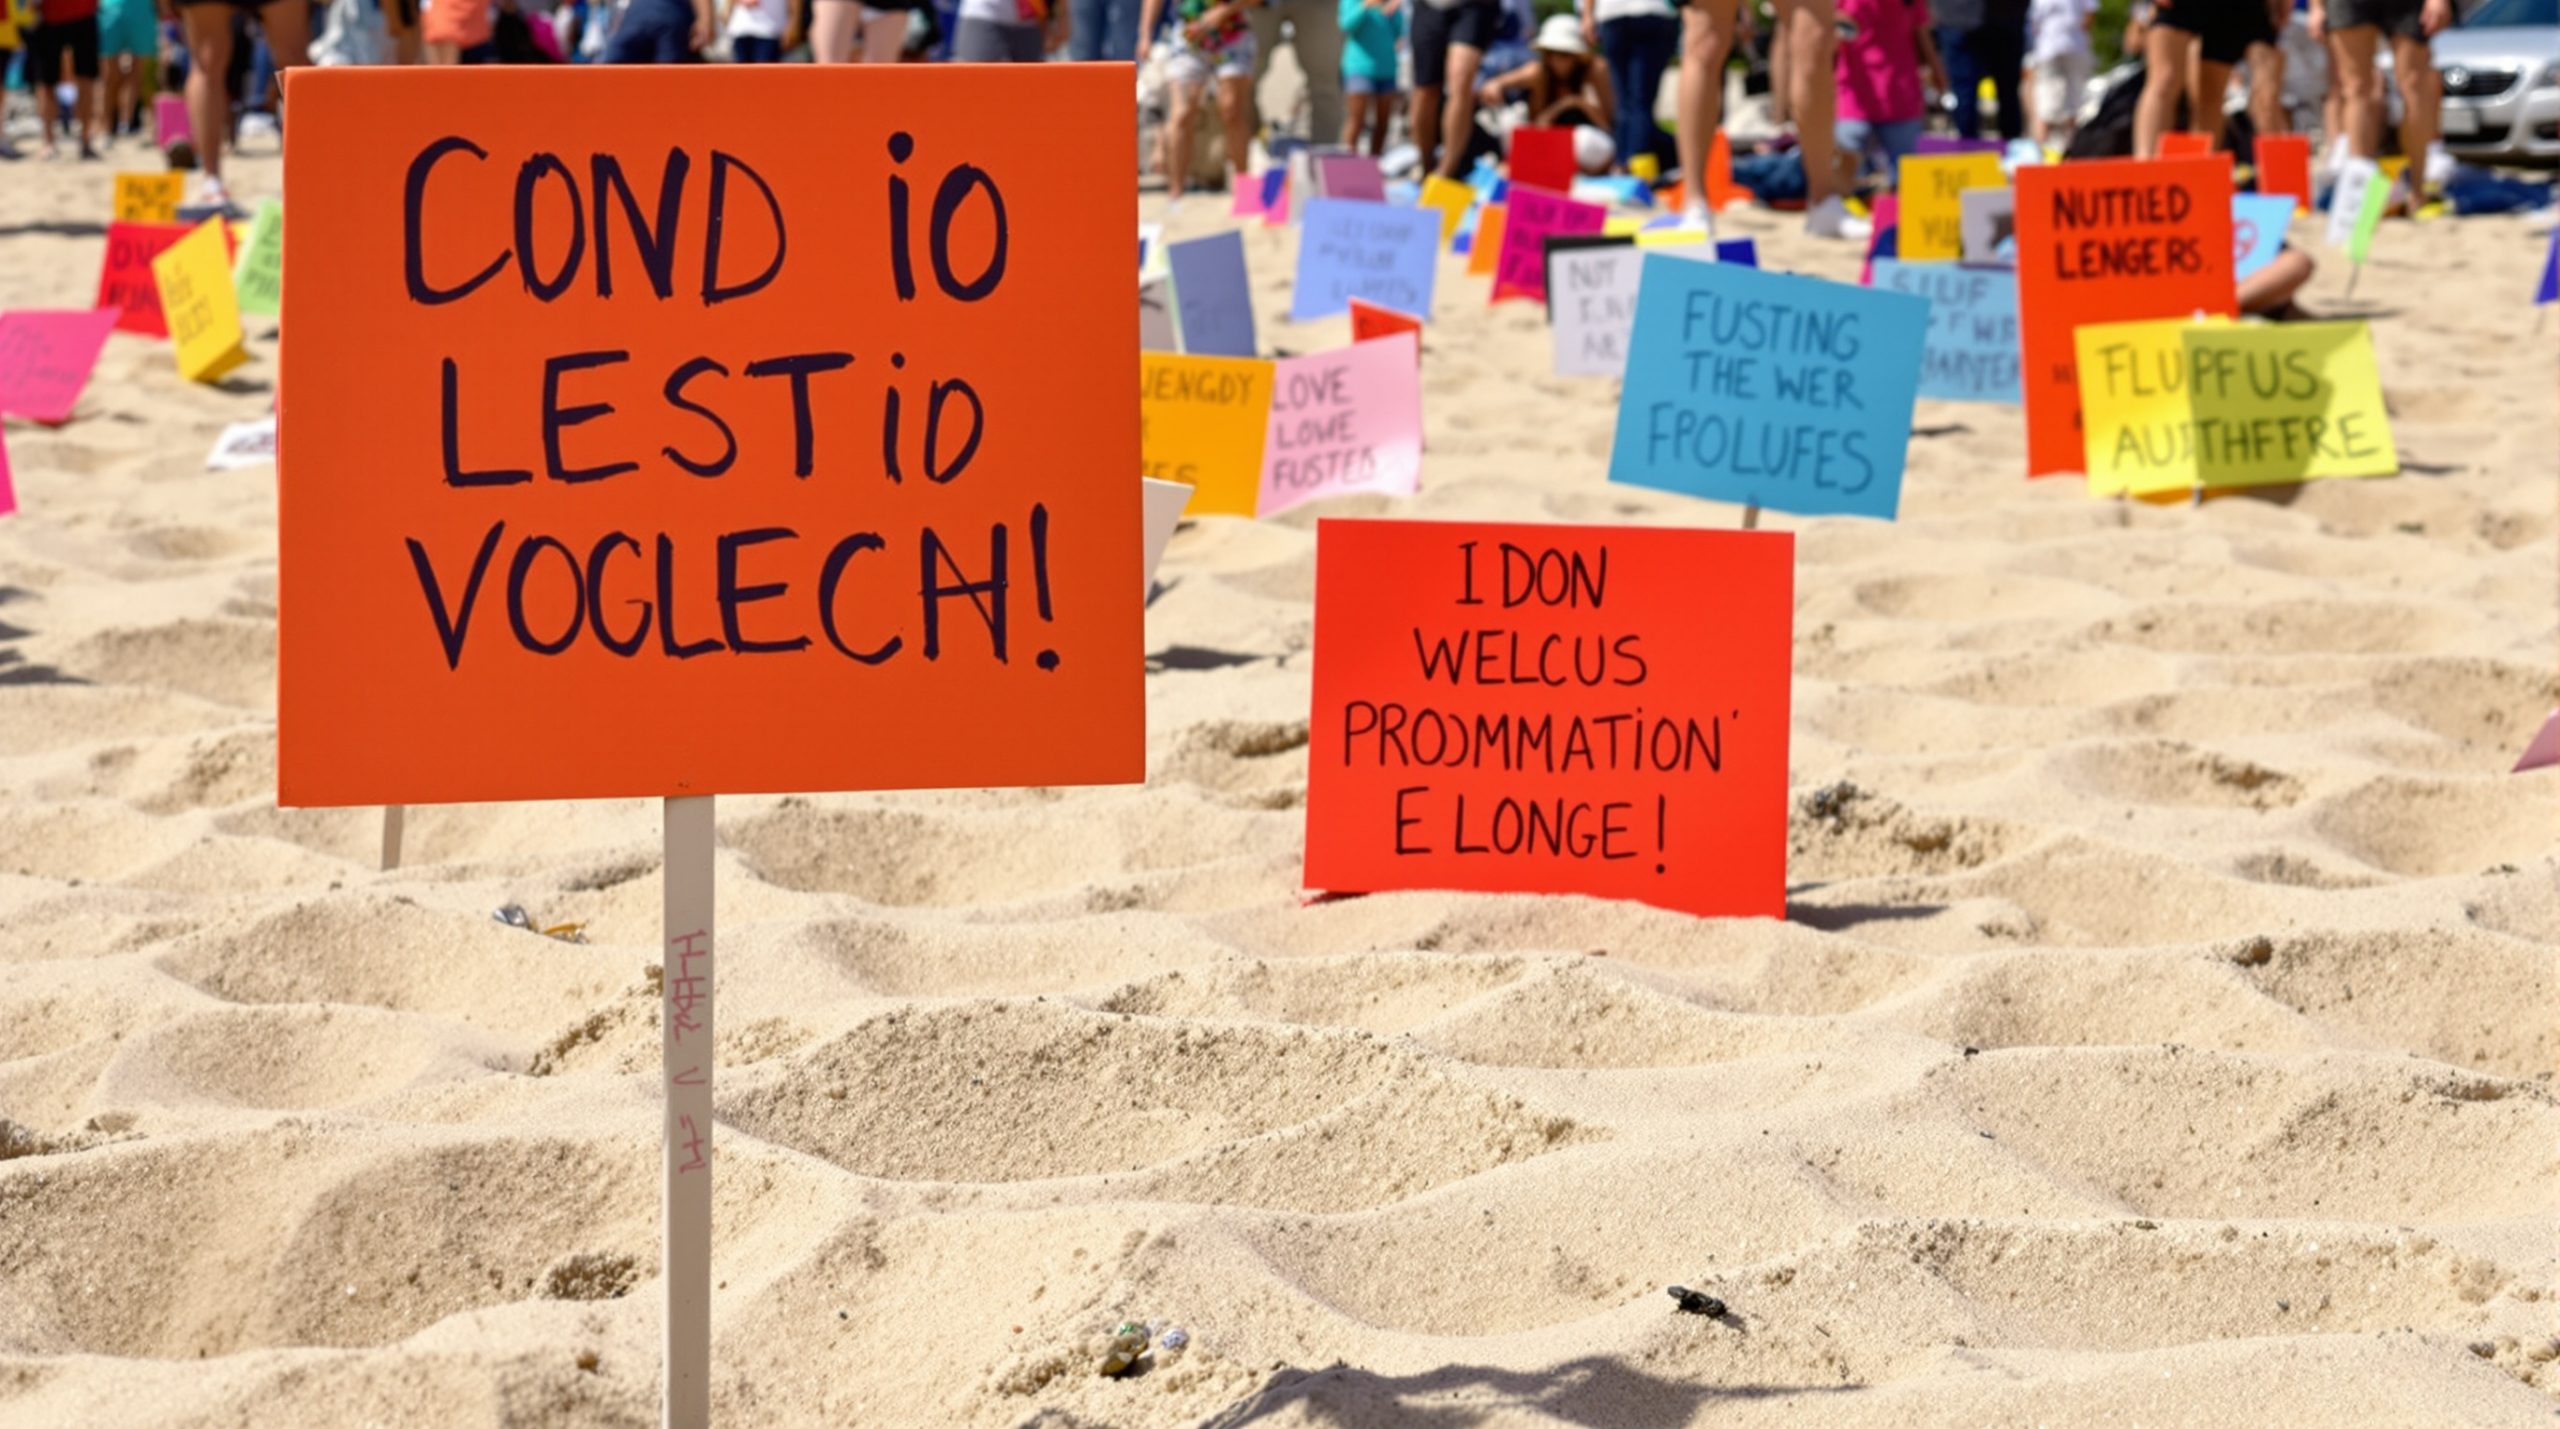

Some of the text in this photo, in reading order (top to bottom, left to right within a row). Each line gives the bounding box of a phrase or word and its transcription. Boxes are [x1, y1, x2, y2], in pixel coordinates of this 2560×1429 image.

[404, 136, 788, 308] COND
[1683, 288, 1861, 363] FUSTING
[1683, 350, 1759, 400] THE
[1774, 364, 1864, 411] WER
[1456, 541, 1609, 610] I DON
[1412, 627, 1649, 688] WELCUS
